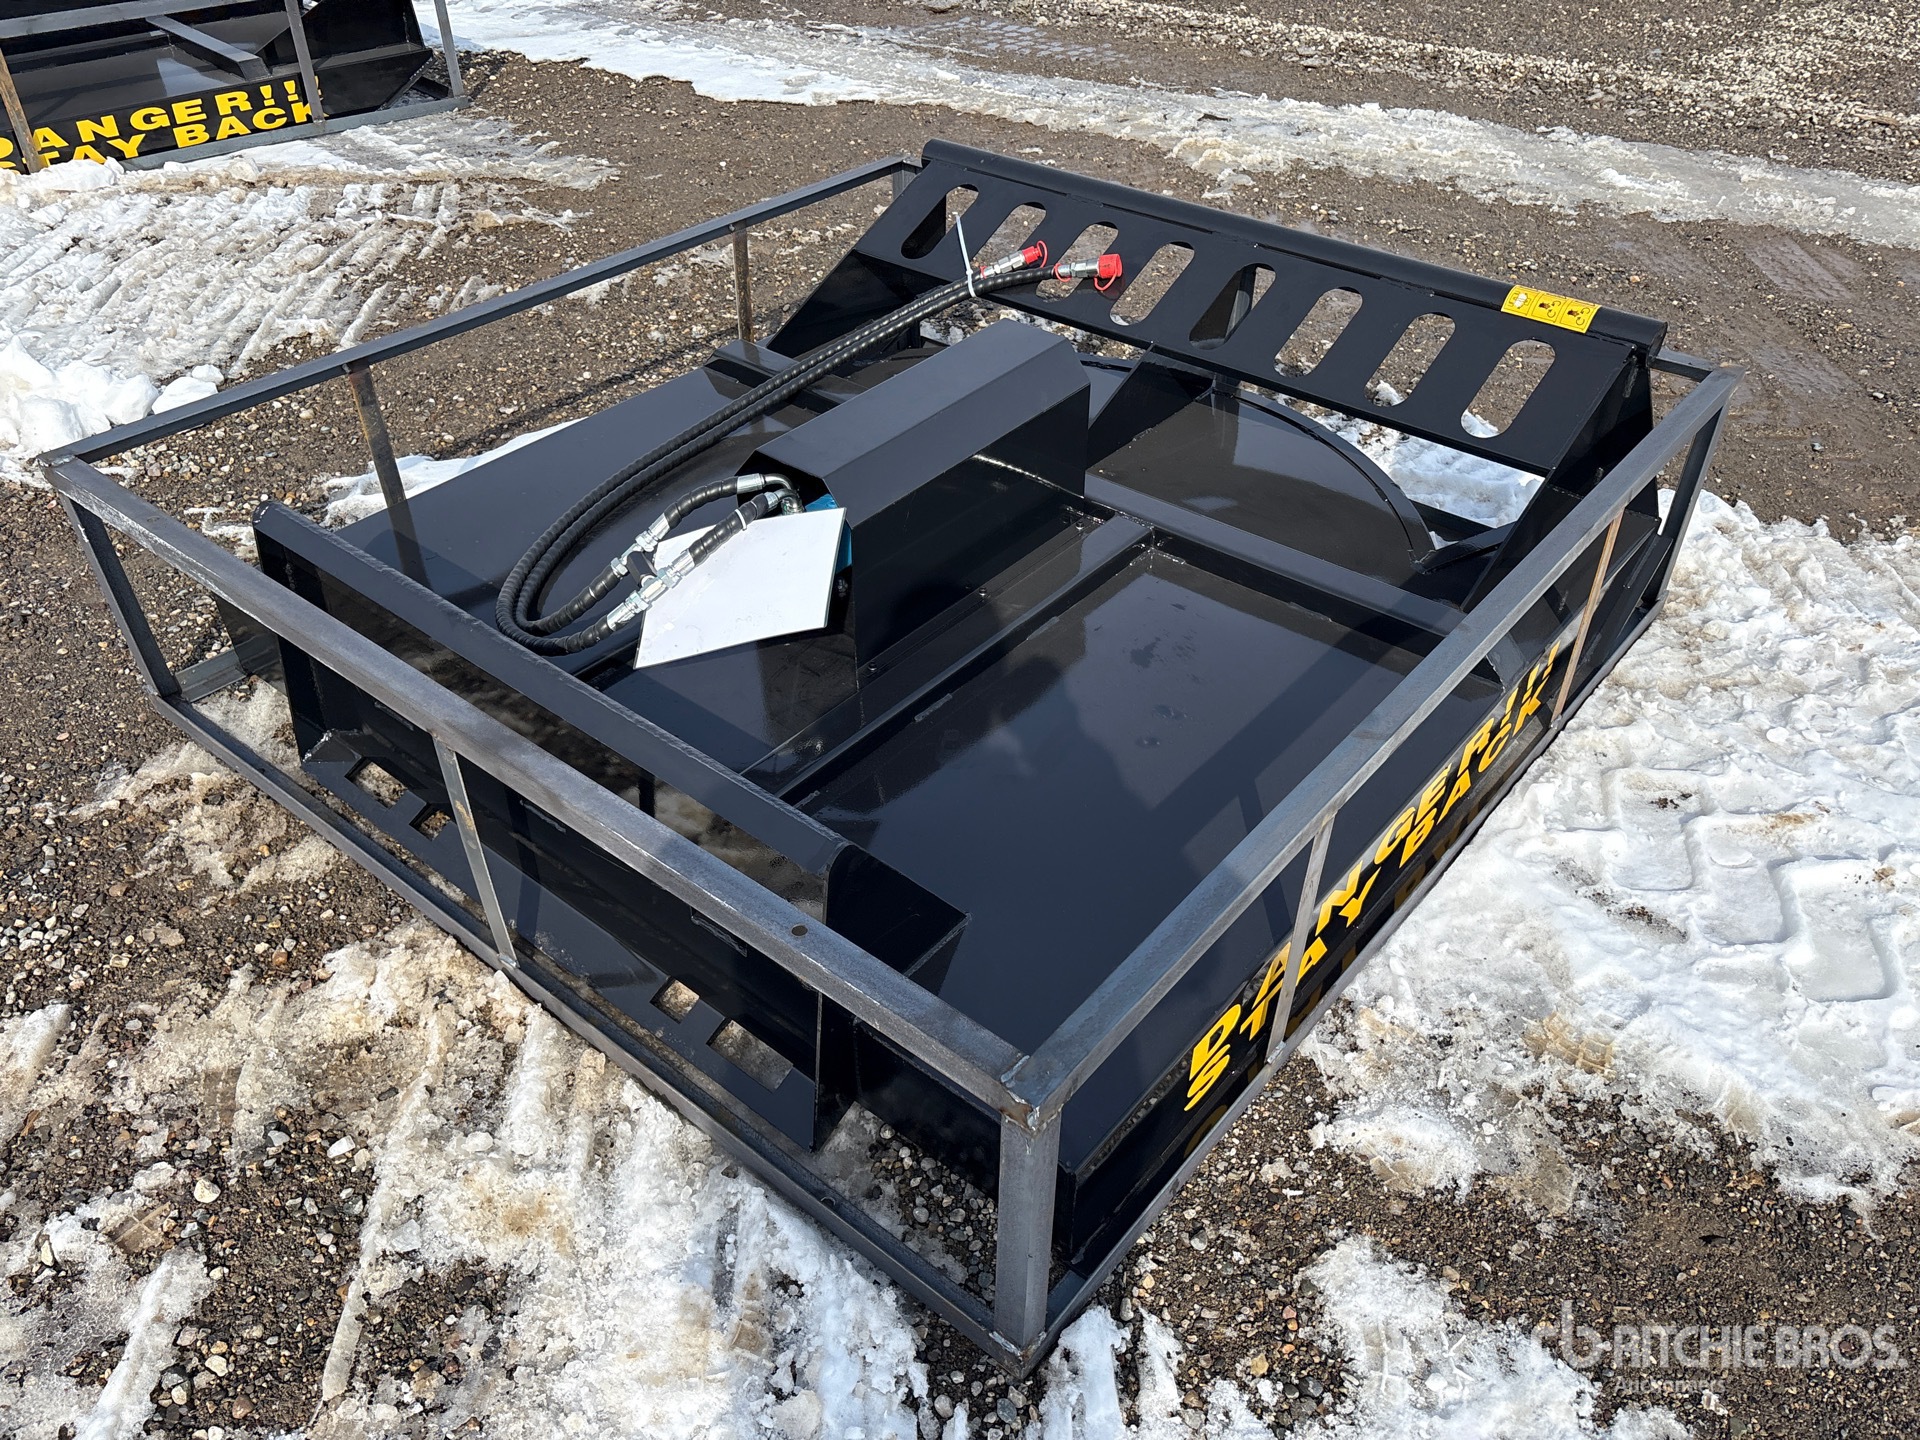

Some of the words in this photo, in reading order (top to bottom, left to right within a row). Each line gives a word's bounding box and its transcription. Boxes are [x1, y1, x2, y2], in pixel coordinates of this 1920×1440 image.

[1184, 867, 1381, 1111] STAY
[1399, 676, 1541, 868] BACK
[1189, 640, 1560, 1081] DANGER!!!
